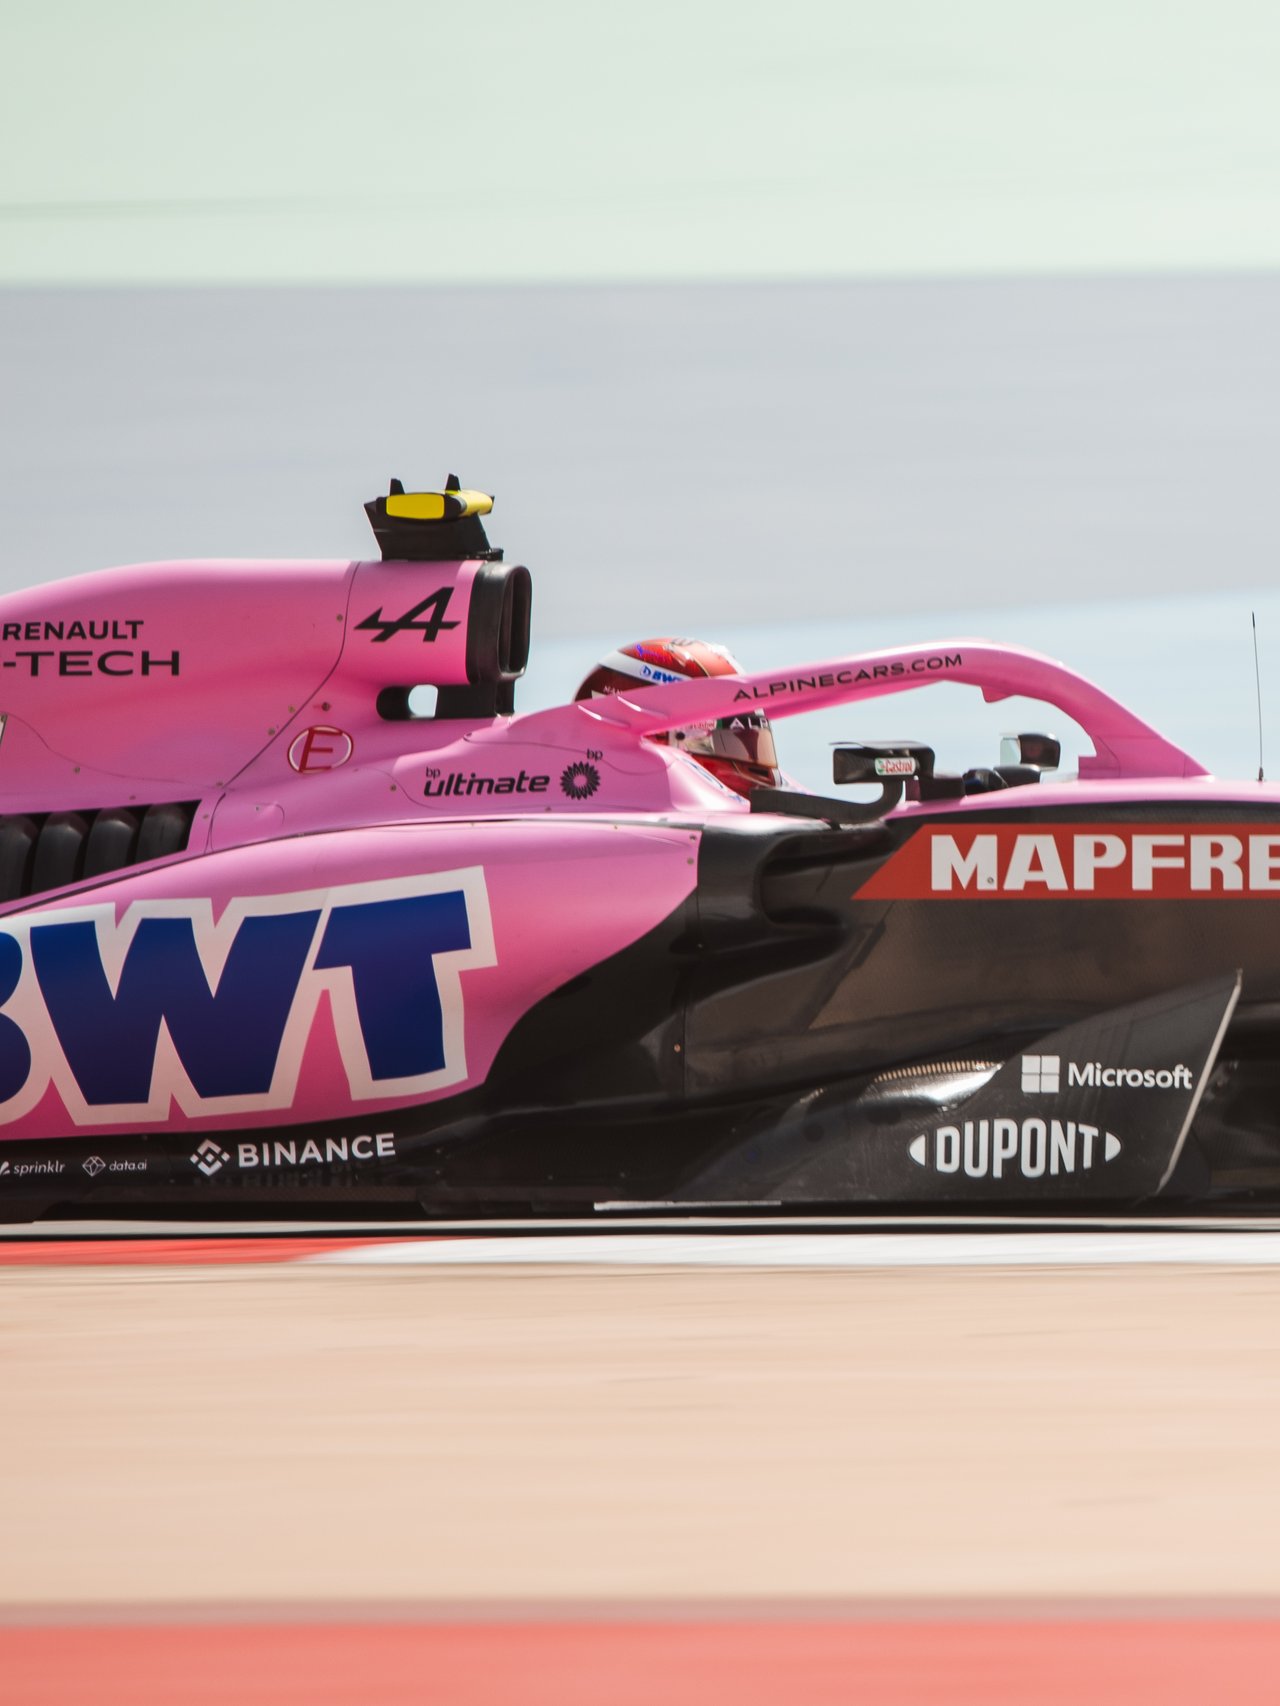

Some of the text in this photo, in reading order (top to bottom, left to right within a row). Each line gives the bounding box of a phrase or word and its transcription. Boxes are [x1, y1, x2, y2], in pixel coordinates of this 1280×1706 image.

[2, 620, 144, 640] RENAULT
[733, 654, 962, 702] ALPINECARS.COM
[299, 726, 344, 773] E
[587, 748, 603, 761] bp
[423, 770, 550, 797] ultimate
[426, 766, 441, 779] bp
[0, 889, 472, 1107] WT
[1068, 1062, 1193, 1091] Microsoft
[238, 1132, 396, 1168] BINANCE
[935, 1118, 1099, 1178] DUPONT
[13, 1160, 65, 1176] sprinklr
